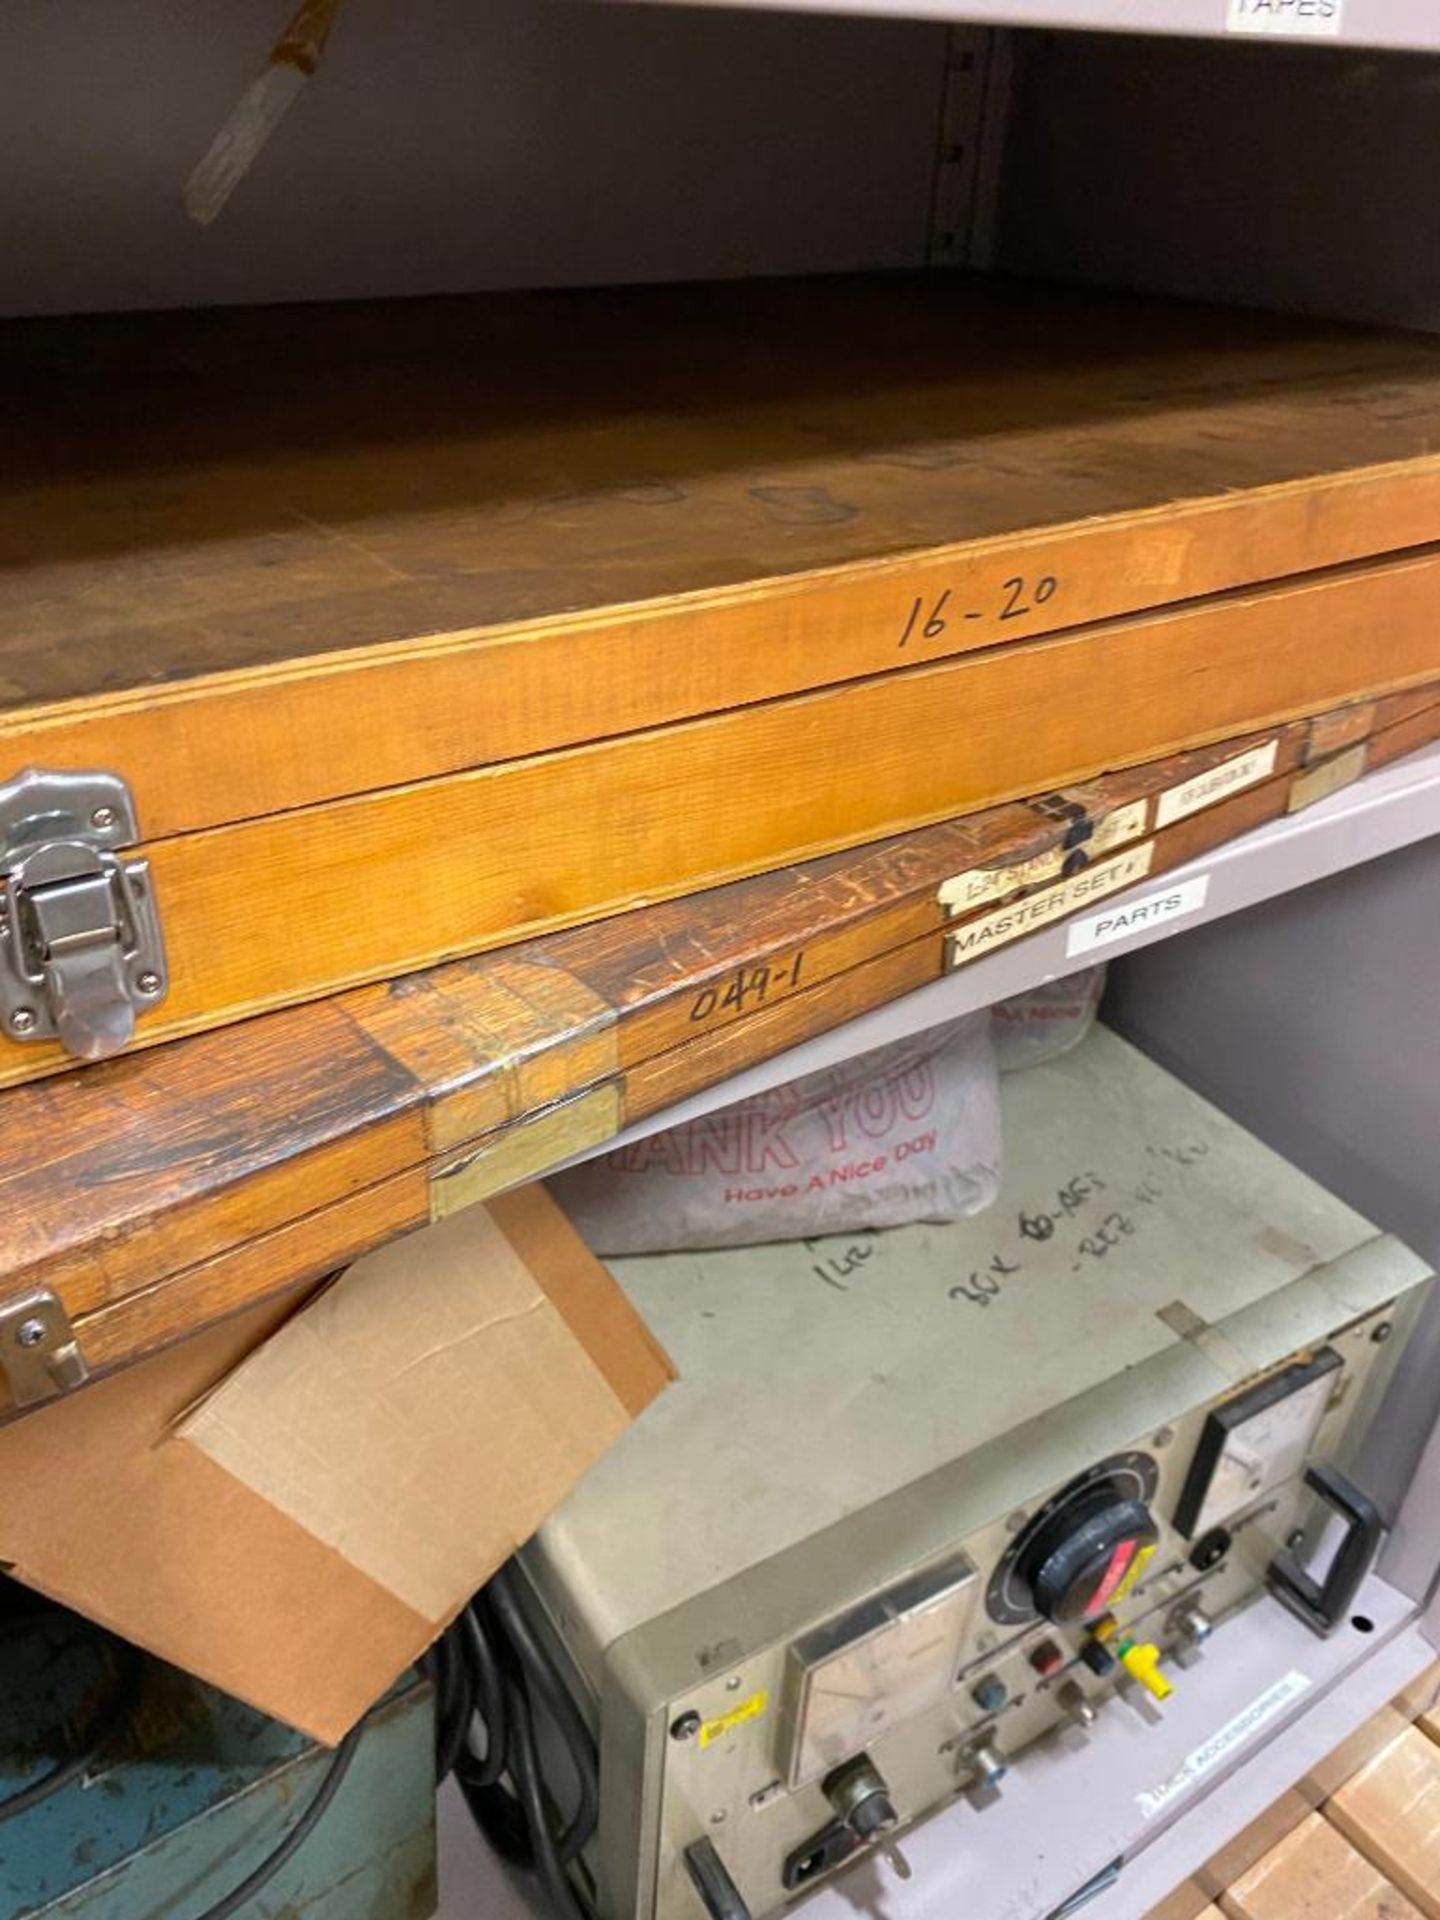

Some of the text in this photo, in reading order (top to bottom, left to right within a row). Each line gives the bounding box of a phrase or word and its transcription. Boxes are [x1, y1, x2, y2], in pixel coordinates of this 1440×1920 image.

[953, 889, 1065, 952] MASTER
[1072, 863, 1120, 898] SET
[1094, 893, 1183, 939] PARTS
[816, 1059, 937, 1154] YOU
[724, 1183, 801, 1204] Have
[807, 1174, 829, 1192] A
[829, 1154, 887, 1187] Nice
[894, 1129, 938, 1165] Day
